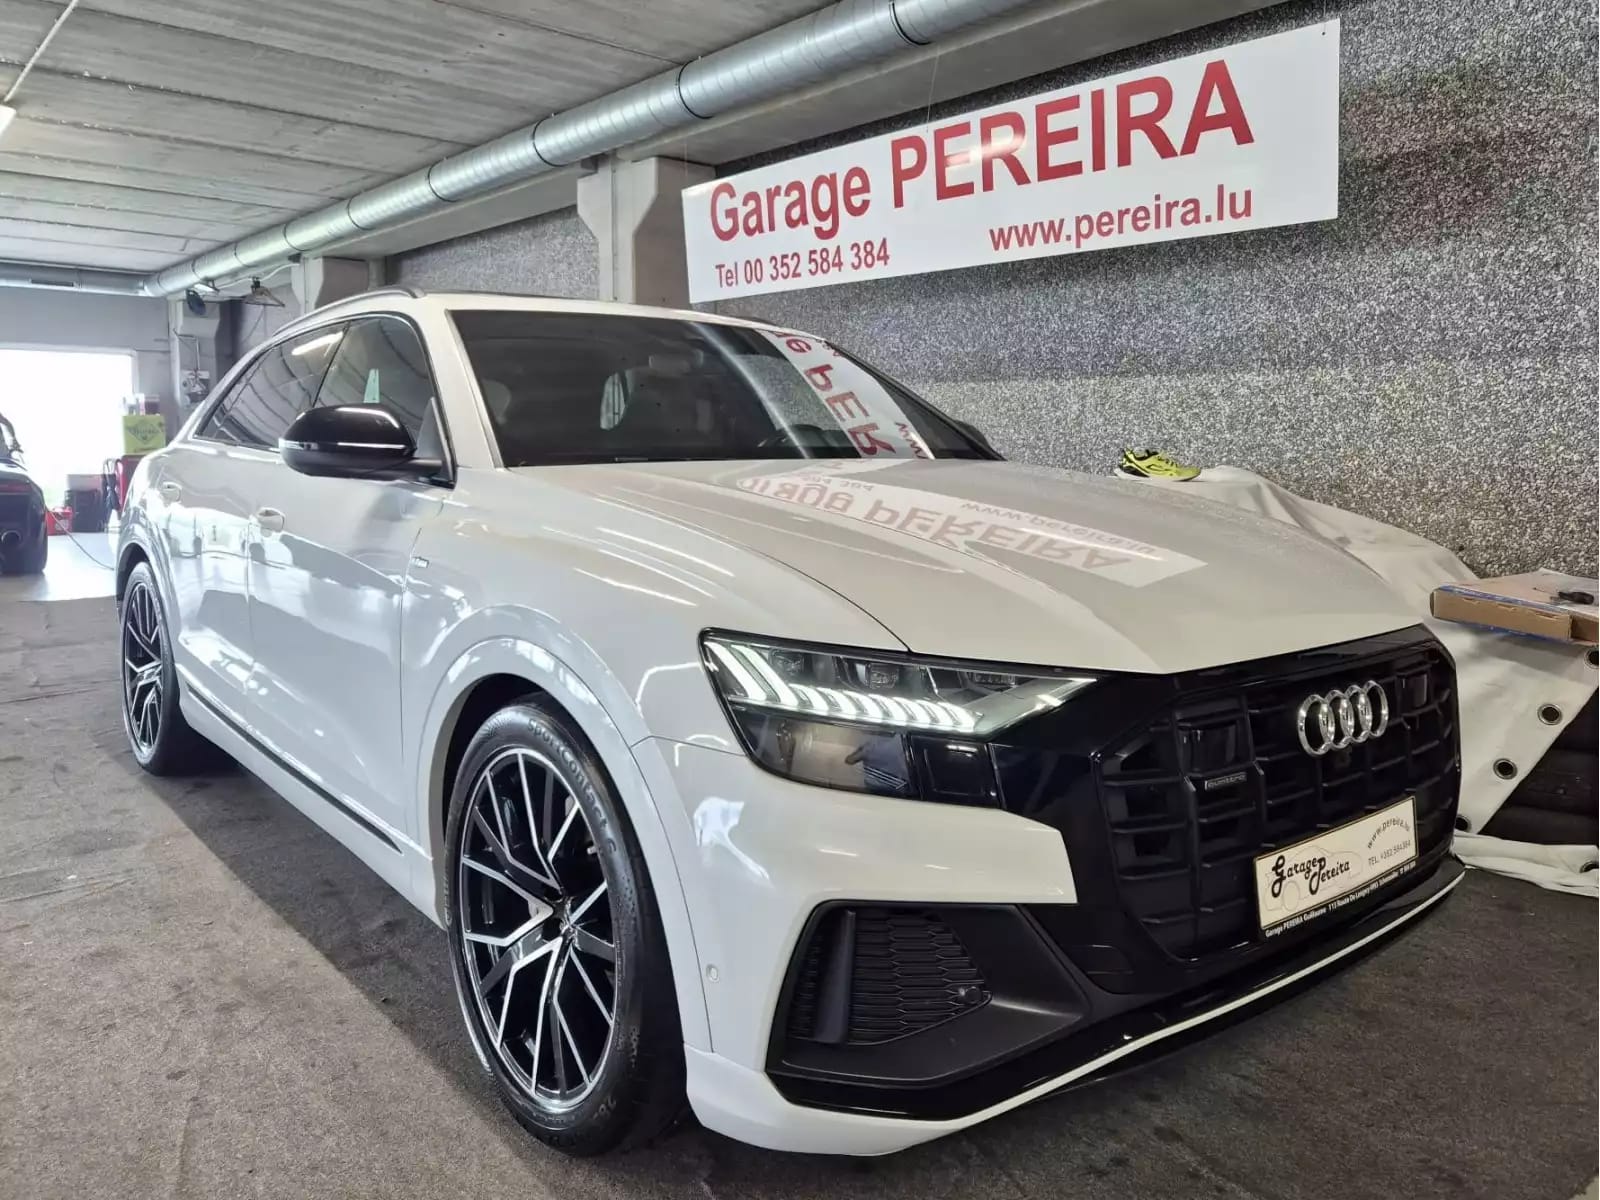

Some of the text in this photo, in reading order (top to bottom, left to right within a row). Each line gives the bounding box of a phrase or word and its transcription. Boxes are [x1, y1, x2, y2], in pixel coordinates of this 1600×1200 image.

[710, 59, 1254, 241] Garage PEREIRA
[989, 184, 1253, 252] www.pereira.lu
[715, 237, 890, 288] Tel 00 352 584 384
[1271, 855, 1318, 898] Garage
[1308, 856, 1350, 896] Pereira
